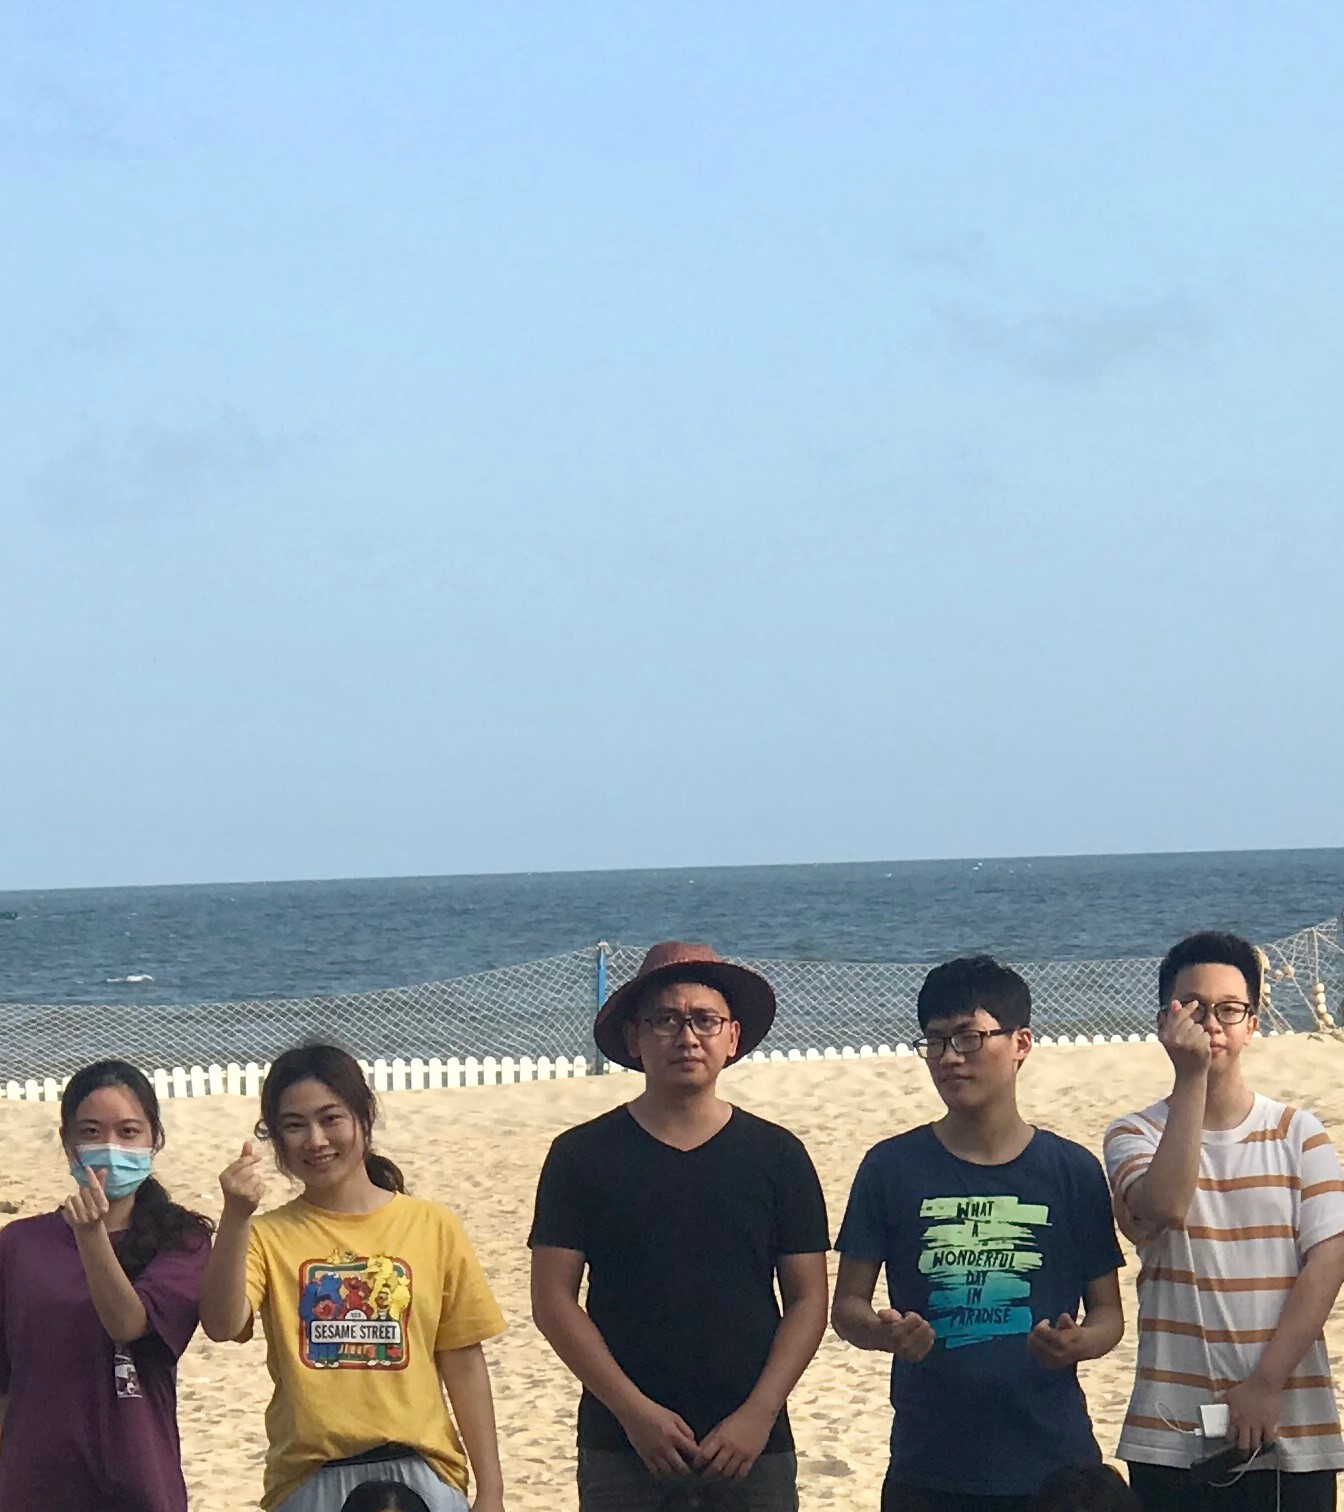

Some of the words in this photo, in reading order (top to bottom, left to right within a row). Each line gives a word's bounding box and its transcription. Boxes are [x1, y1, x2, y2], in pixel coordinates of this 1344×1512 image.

[957, 1201, 995, 1218] WHAT
[971, 1222, 979, 1238] A
[931, 1250, 1016, 1269] WONDERFUL
[965, 1270, 988, 1286] DAY
[967, 1288, 982, 1305] IN
[949, 1307, 1012, 1327] PARADISE
[314, 1324, 356, 1340] SESAME
[359, 1324, 397, 1340] STREET
